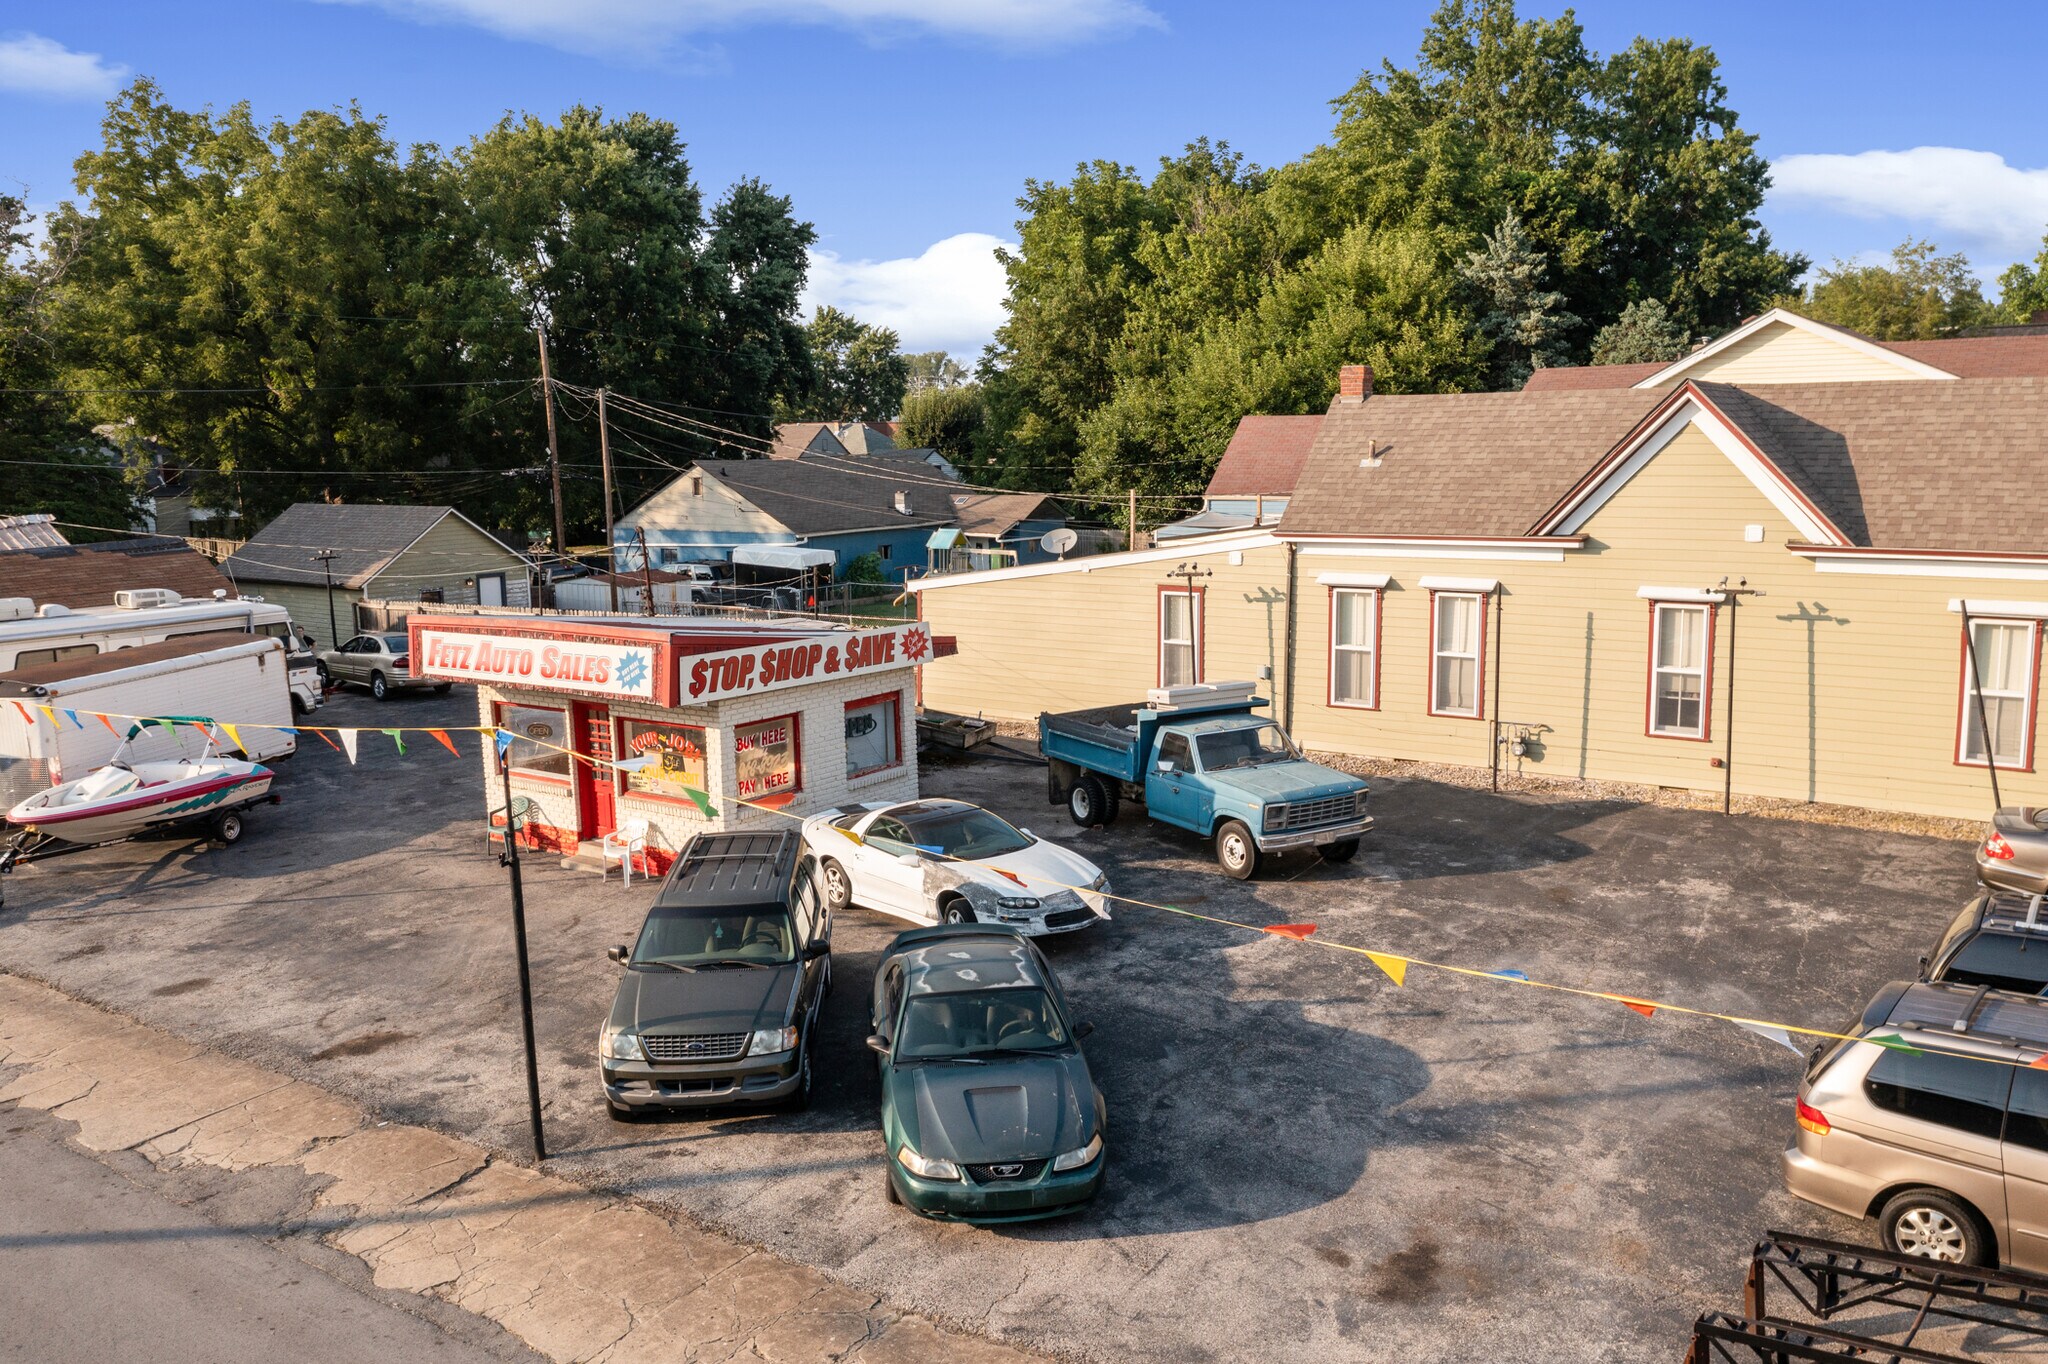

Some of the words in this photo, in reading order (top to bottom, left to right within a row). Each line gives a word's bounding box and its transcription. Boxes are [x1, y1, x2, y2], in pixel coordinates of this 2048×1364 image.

[428, 636, 473, 671] FETZ
[474, 639, 535, 678] AUTO
[539, 645, 612, 685] SALES
[824, 645, 841, 674] &
[529, 725, 549, 736] OPEN
[845, 713, 873, 738] PEN
[629, 731, 659, 755] YOUR
[734, 733, 756, 753] BUY
[760, 727, 786, 747] HERE
[667, 769, 699, 785] CREDIT
[738, 779, 756, 796] PAY
[763, 771, 789, 790] HERE
